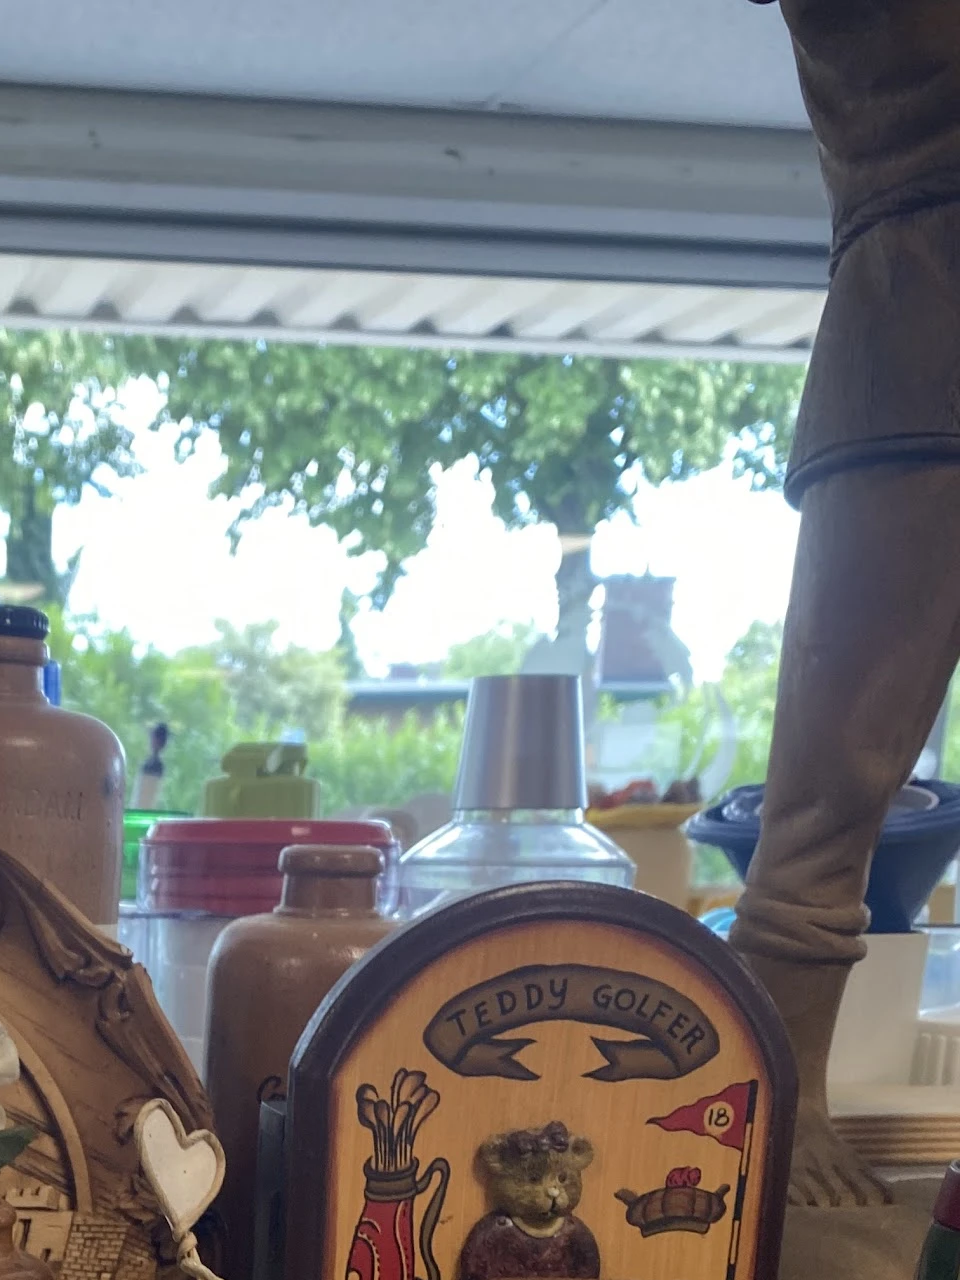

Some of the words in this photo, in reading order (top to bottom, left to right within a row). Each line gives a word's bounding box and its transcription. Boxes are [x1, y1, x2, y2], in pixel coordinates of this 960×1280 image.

[446, 979, 568, 1036] TEDDY
[592, 984, 705, 1055] GOLFER
[708, 1107, 730, 1127] 18
